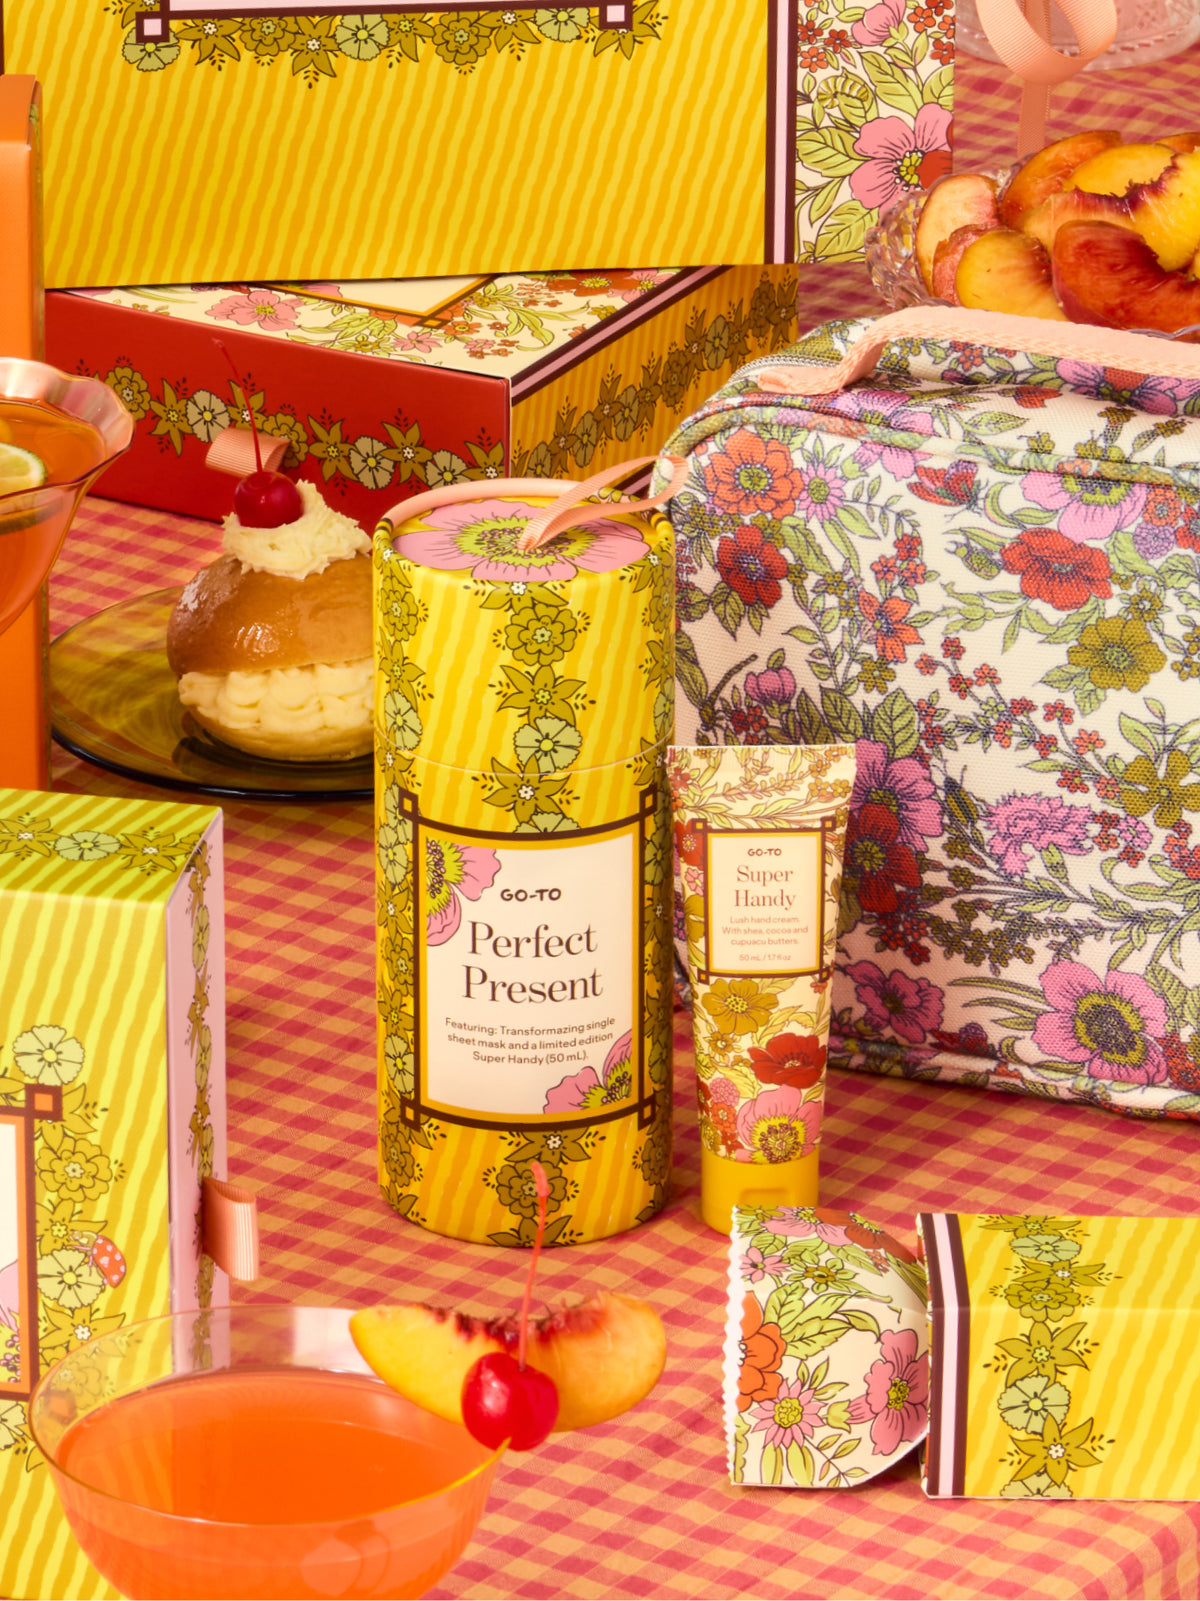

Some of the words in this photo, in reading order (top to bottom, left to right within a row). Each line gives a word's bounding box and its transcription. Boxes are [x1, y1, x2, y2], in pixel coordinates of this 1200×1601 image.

[748, 848, 782, 856] GO-TO
[737, 865, 794, 886] Super
[500, 888, 562, 902] GO-TO
[734, 889, 796, 910] Handy
[730, 916, 749, 924] Lush
[468, 921, 598, 958] Perfect
[462, 965, 603, 1003] Present
[445, 1017, 498, 1035] Featuring:
[501, 1025, 585, 1036] Transformazing
[586, 1017, 615, 1032] single
[448, 1034, 476, 1046] sheet
[478, 1040, 506, 1049] mask
[508, 1041, 529, 1050] and
[539, 1039, 576, 1049] limited
[578, 1032, 613, 1045] edition
[473, 1051, 504, 1063] Super
[508, 1052, 544, 1065] Handy
[546, 1053, 564, 1064] (50
[567, 1050, 588, 1062] mL).
